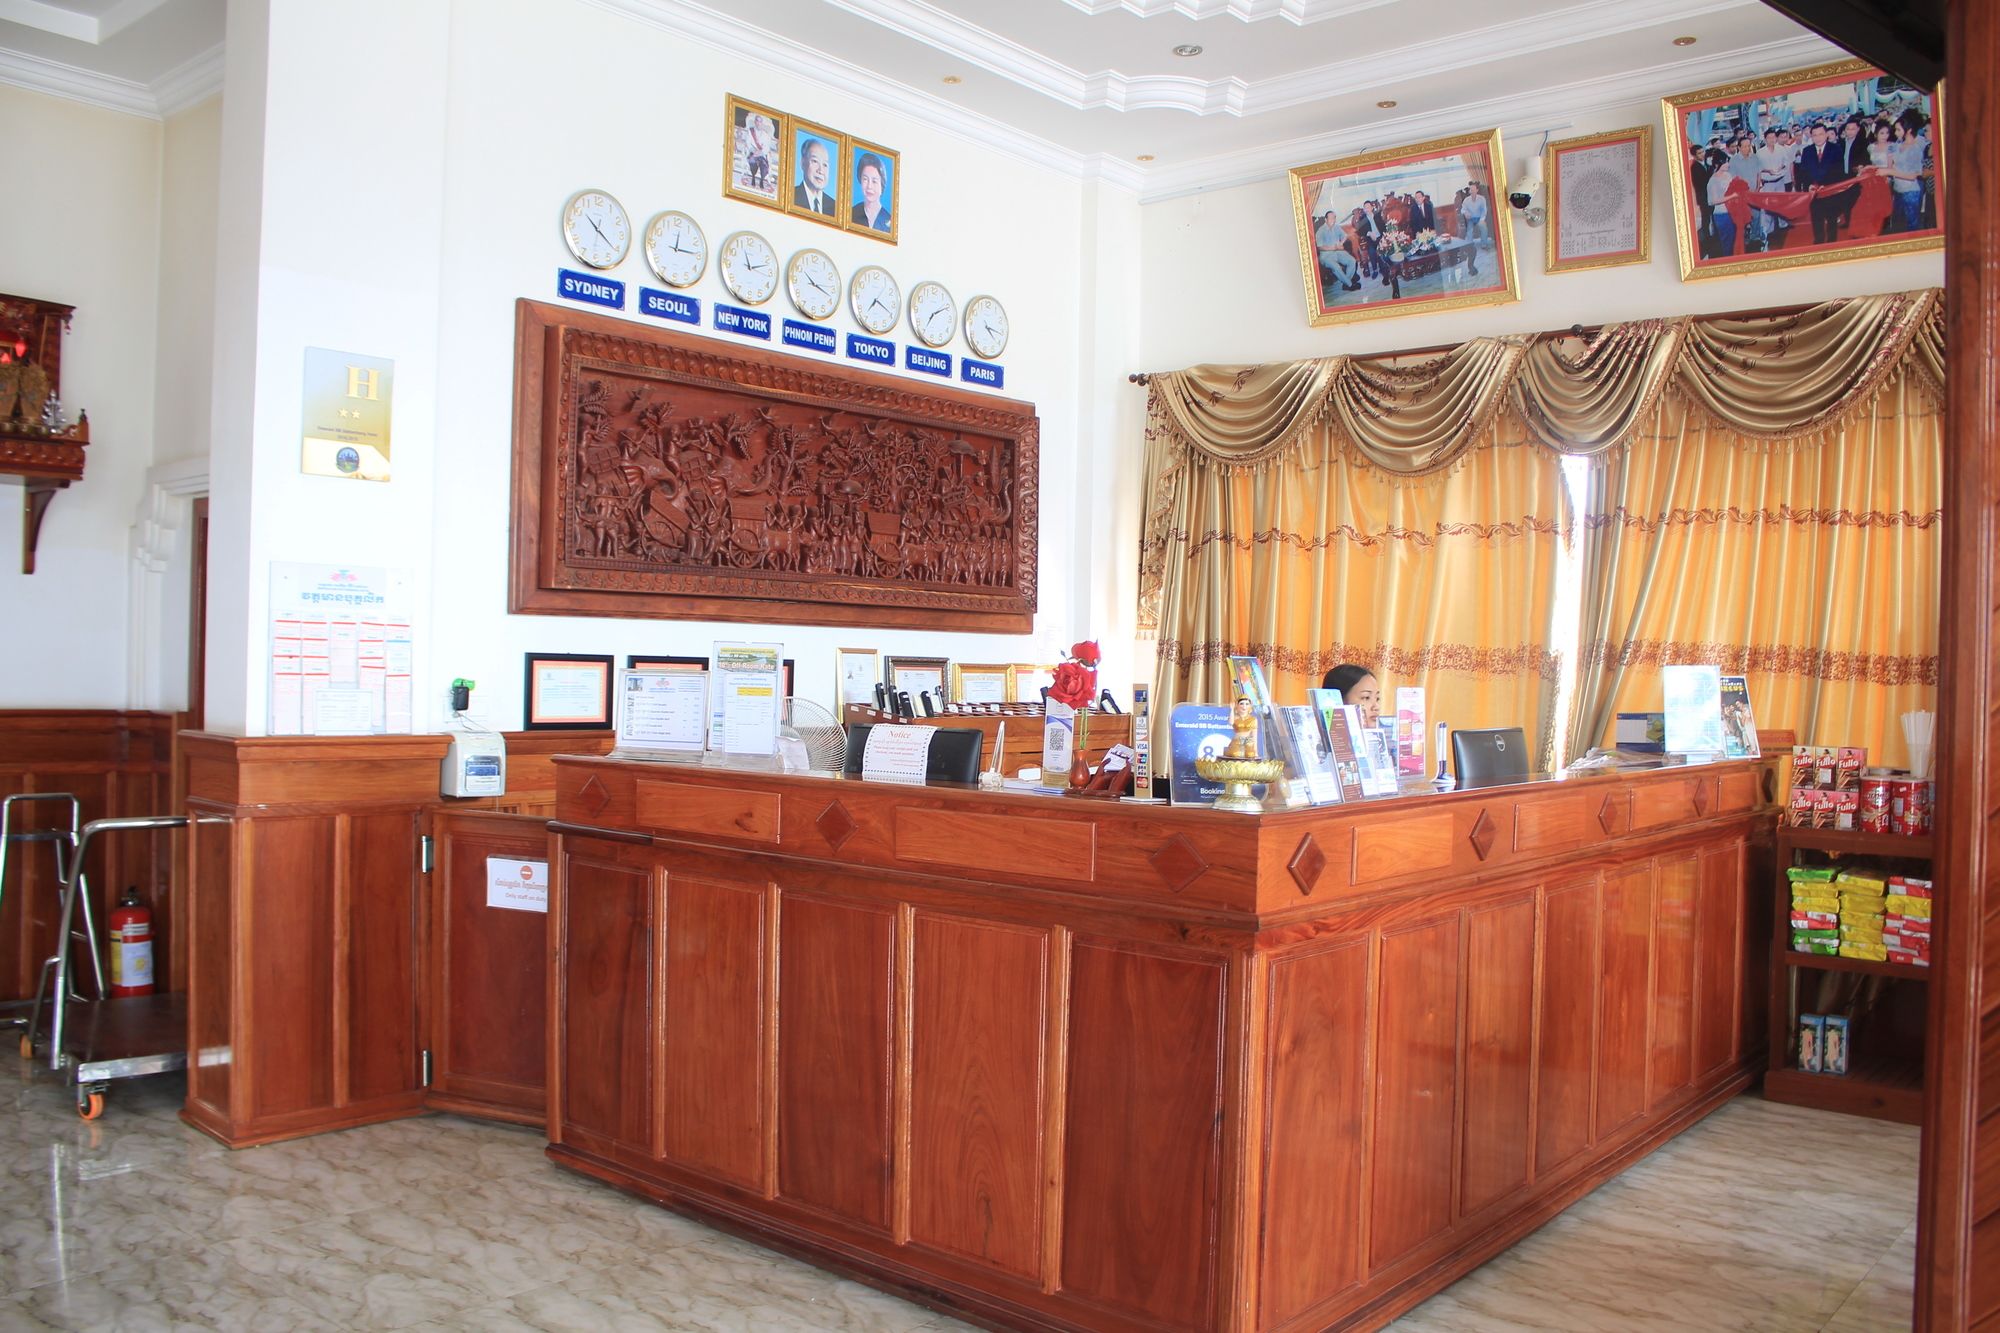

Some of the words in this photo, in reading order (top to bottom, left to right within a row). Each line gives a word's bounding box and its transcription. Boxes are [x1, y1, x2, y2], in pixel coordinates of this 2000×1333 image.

[564, 279, 619, 301] SYDNEY
[648, 296, 691, 317] SEOUL
[717, 313, 739, 328] NEW
[740, 316, 768, 333] YORK
[784, 326, 813, 343] PHNOM
[814, 332, 835, 348] PENH
[853, 342, 889, 359] TOKYO
[911, 354, 947, 371] BEIJING
[970, 366, 995, 382] PARIS
[345, 364, 382, 401] H
[761, 663, 775, 671] Rate
[1198, 713, 1213, 721] 2015
[889, 730, 912, 739] Notice
[1793, 756, 1813, 765] Fullo
[1816, 757, 1835, 767] Fullo
[1838, 759, 1859, 768] Fullo
[1792, 800, 1811, 809] Fullo
[1814, 801, 1834, 811] Fullo
[1836, 803, 1856, 812] Fullo
